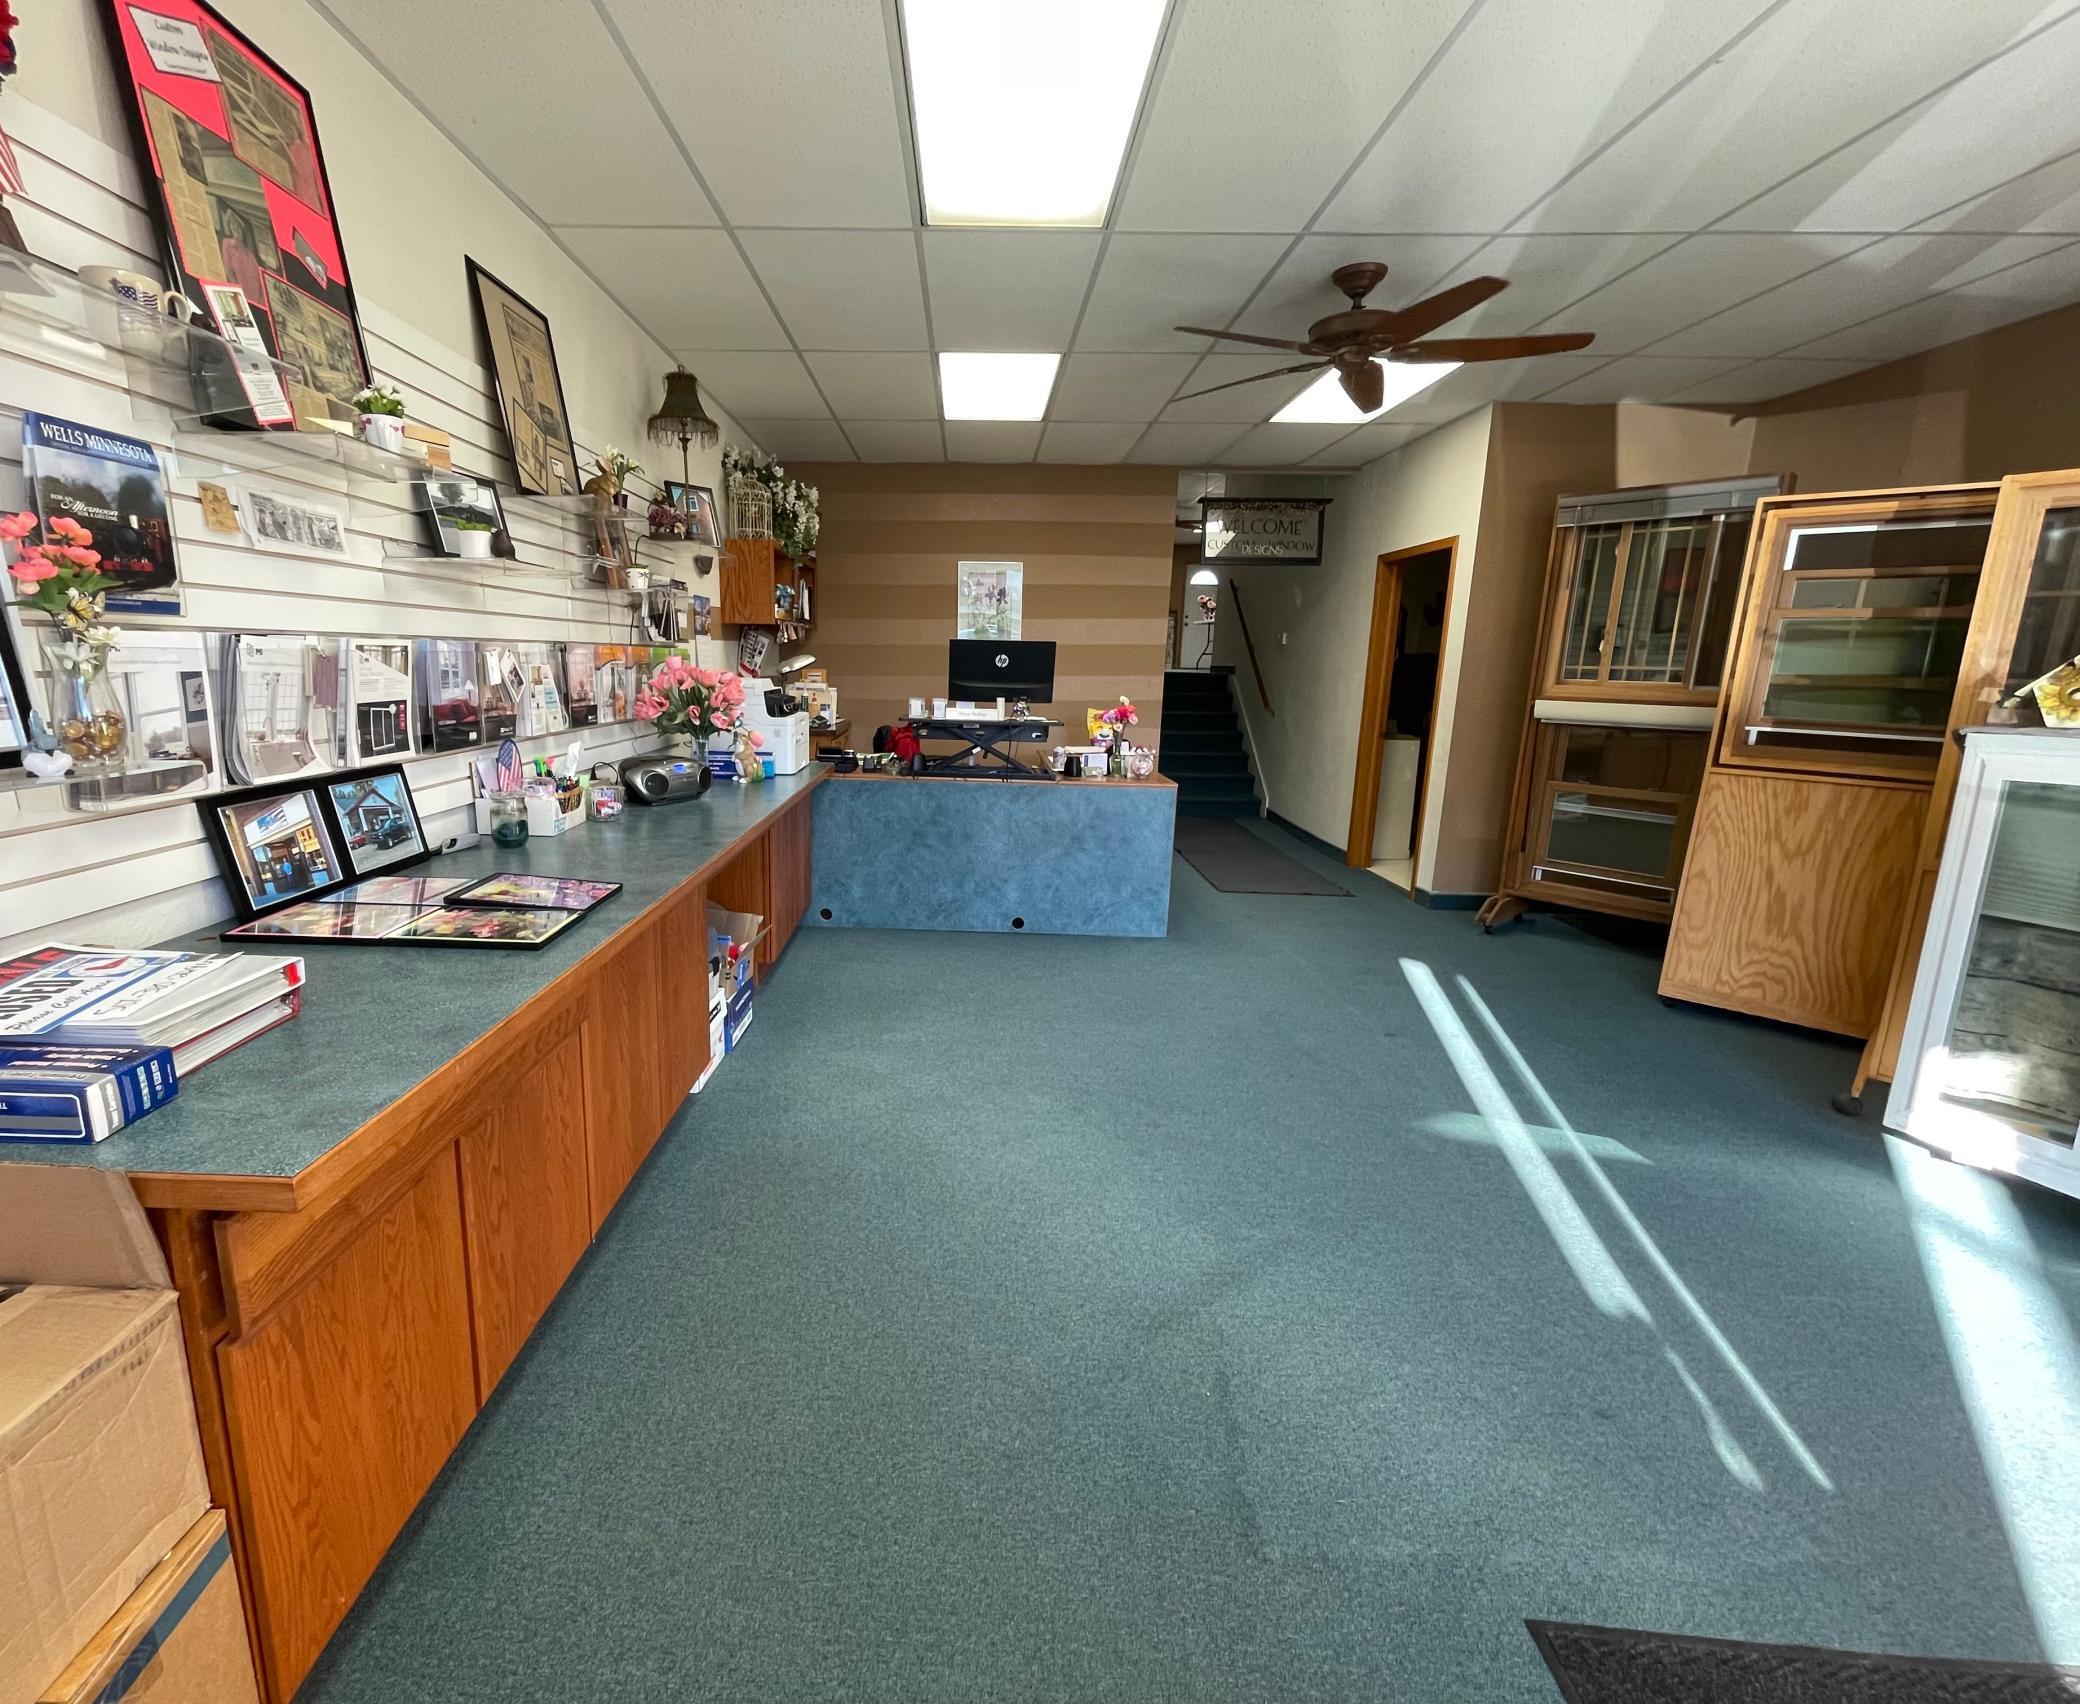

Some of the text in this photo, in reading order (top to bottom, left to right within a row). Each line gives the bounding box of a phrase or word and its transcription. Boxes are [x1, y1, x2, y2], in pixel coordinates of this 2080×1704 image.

[40, 422, 84, 447] WELLS
[84, 432, 153, 463] MINNESOTA
[60, 500, 119, 517] Afternoon
[1217, 518, 1302, 536] WELCOME
[1241, 543, 1284, 557] DESIGNS
[996, 654, 1009, 668] hp
